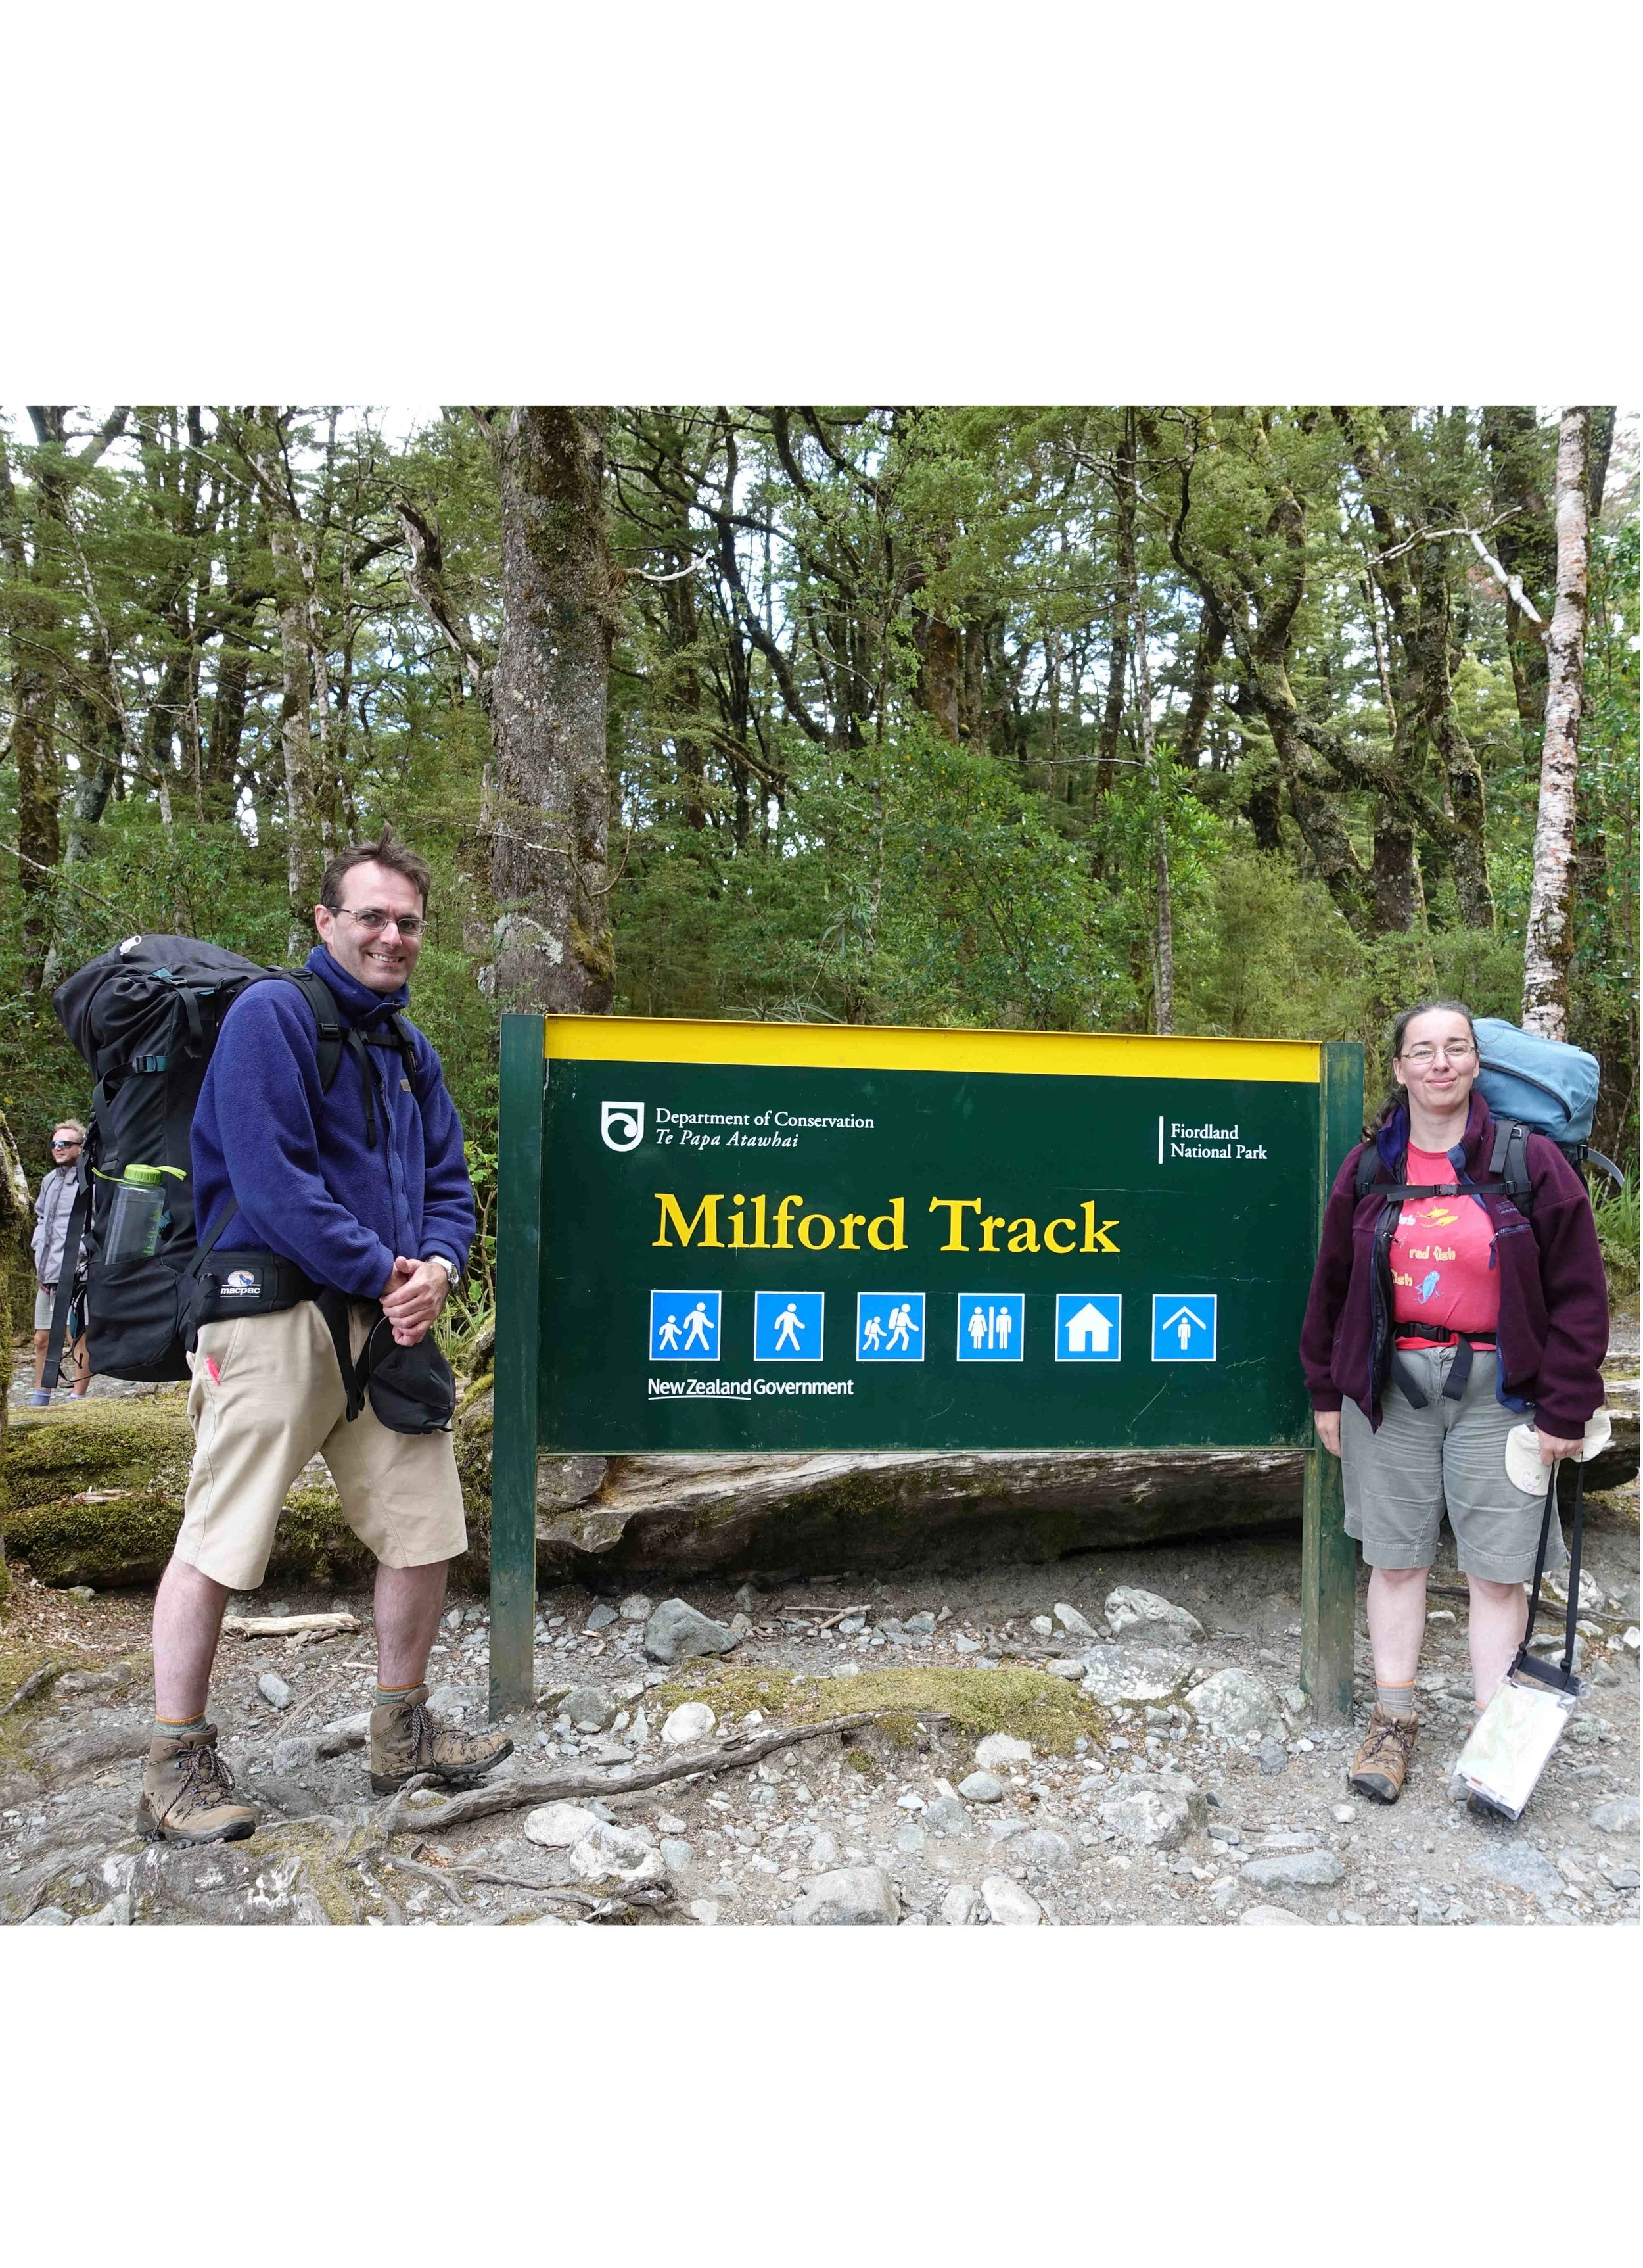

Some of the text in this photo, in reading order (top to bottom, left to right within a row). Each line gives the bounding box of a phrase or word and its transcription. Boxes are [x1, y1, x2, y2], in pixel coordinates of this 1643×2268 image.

[655, 1108, 875, 1129] Department of Conservation
[656, 1129, 799, 1150] Te Papa Atawhai
[1170, 1123, 1239, 1140] Fiordland
[1170, 1143, 1268, 1160] National Park
[651, 1193, 1121, 1254] Milford Track
[1409, 1245, 1456, 1262] red fish
[648, 1378, 854, 1396] New Zealand Government
